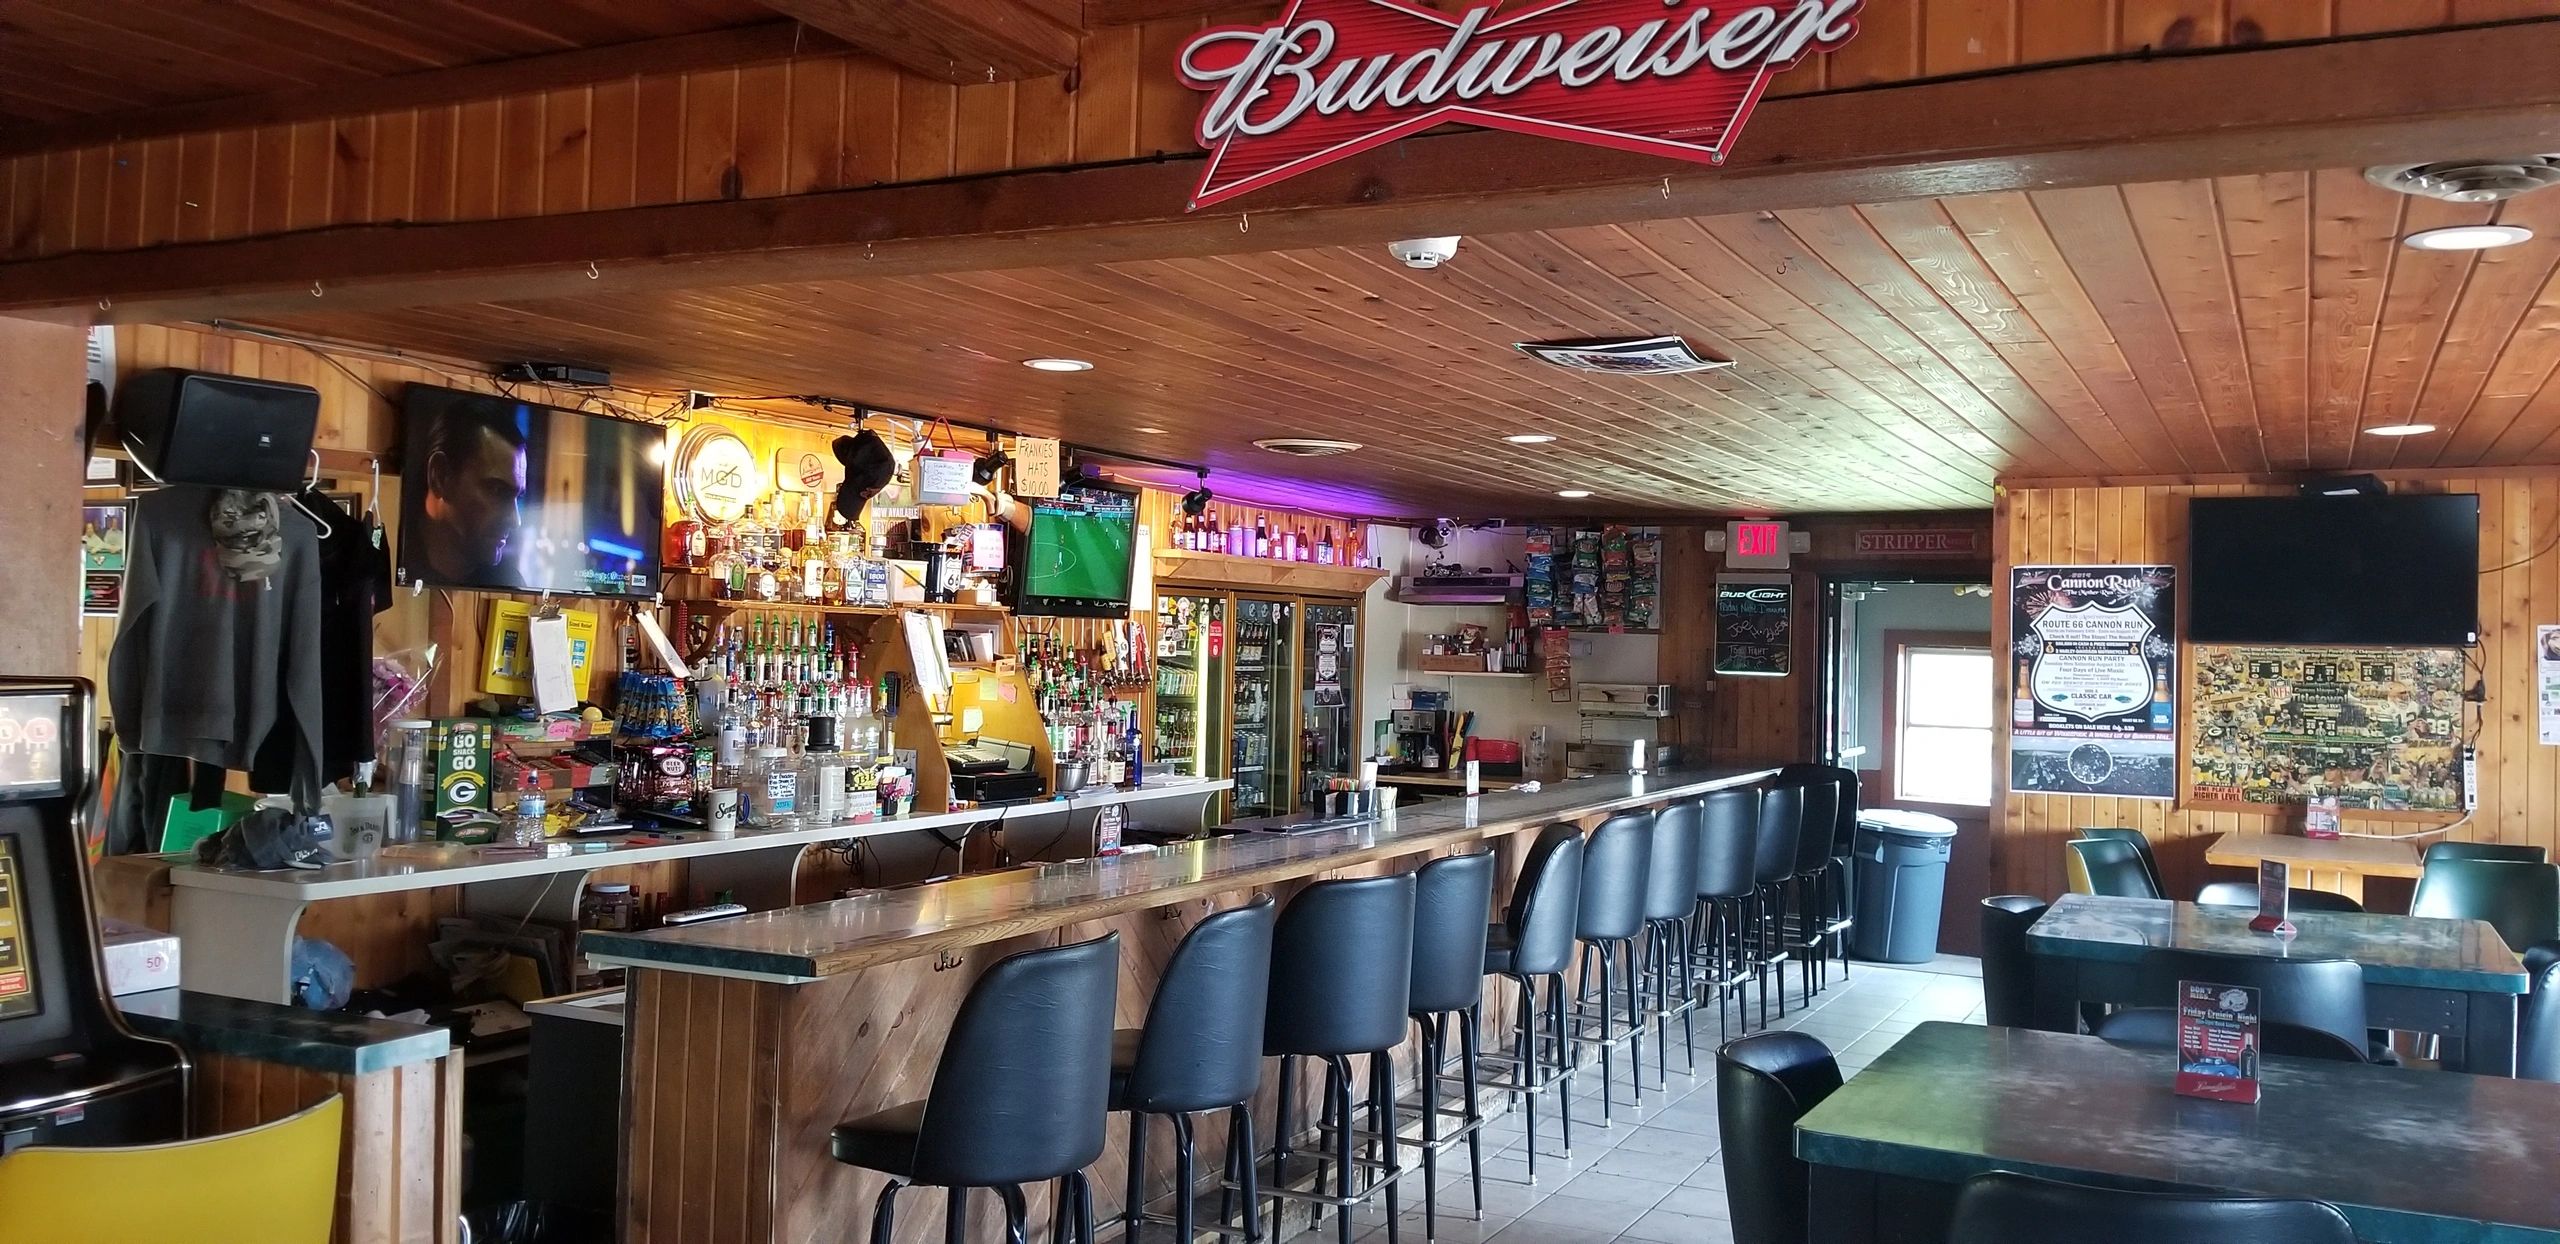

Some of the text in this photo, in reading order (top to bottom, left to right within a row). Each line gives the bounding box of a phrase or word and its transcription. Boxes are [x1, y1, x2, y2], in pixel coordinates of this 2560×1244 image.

[1181, 0, 1859, 139] Budweiser
[1028, 461, 1049, 477] HATS
[701, 467, 743, 488] MGD
[1737, 524, 1780, 556] EXIT
[1861, 534, 1949, 550] STRIPPER
[948, 573, 961, 586] 66
[2047, 575, 2142, 593] Cannon Run
[2042, 620, 2144, 629] ROUTE 66 CANNON RUN
[2272, 688, 2290, 697] NFL
[2291, 693, 2348, 703] Titletown!
[453, 734, 476, 749] GO
[453, 748, 476, 756] SNACK
[452, 756, 476, 770] GO
[2194, 792, 2219, 800] HIGHER
[146, 956, 161, 969] 50
[2183, 1006, 2206, 1020] Friday
[2237, 1012, 2257, 1026] Night
